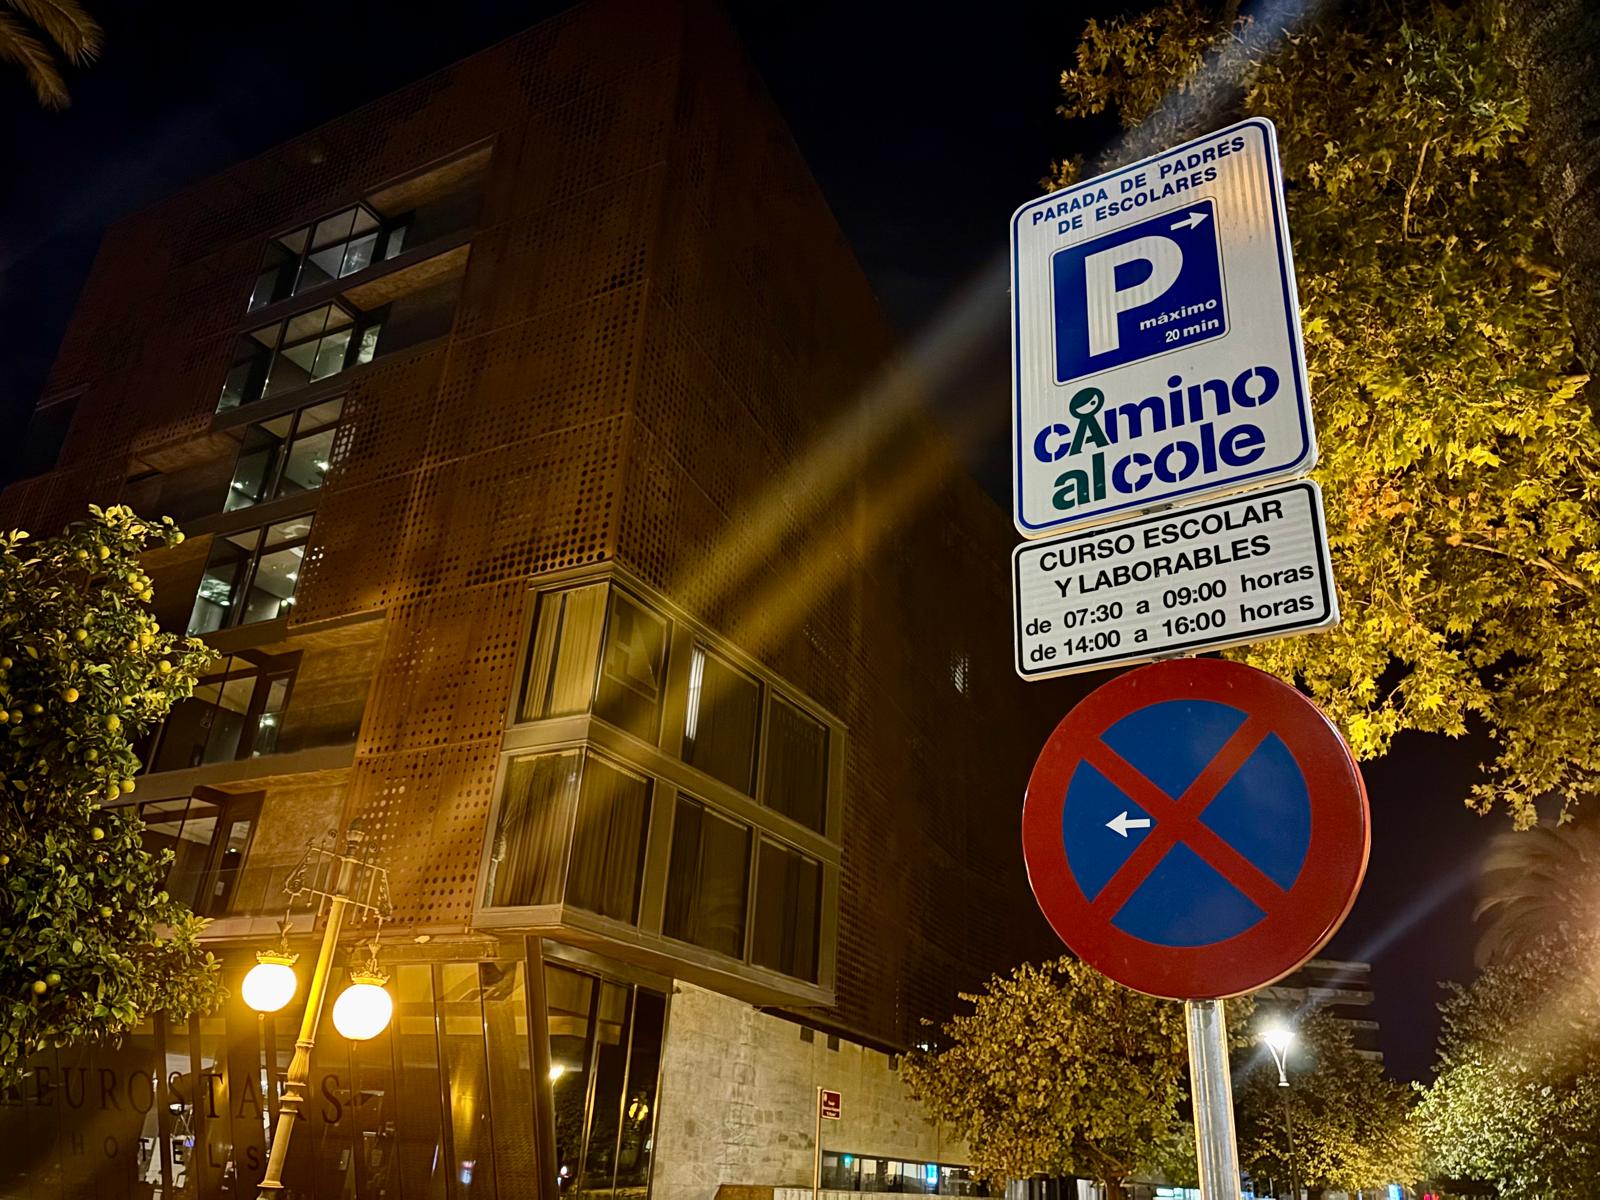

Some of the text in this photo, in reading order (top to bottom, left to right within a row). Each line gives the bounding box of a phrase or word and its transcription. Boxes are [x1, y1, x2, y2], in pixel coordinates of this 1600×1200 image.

[1033, 136, 1245, 225] PARADA DE PADRES
[1057, 167, 1217, 234] DE ESCOLARES
[1085, 235, 1184, 357] P
[1140, 299, 1217, 330] máximo
[1165, 318, 1219, 343] 20 min
[1039, 499, 1284, 572] CURSO ESCOLAR
[1054, 535, 1271, 598] Y LABORABLES
[1025, 565, 1314, 636] de 07:30 a 09:00 horas
[1030, 595, 1314, 662] de 14:00 a 16:00 horas
